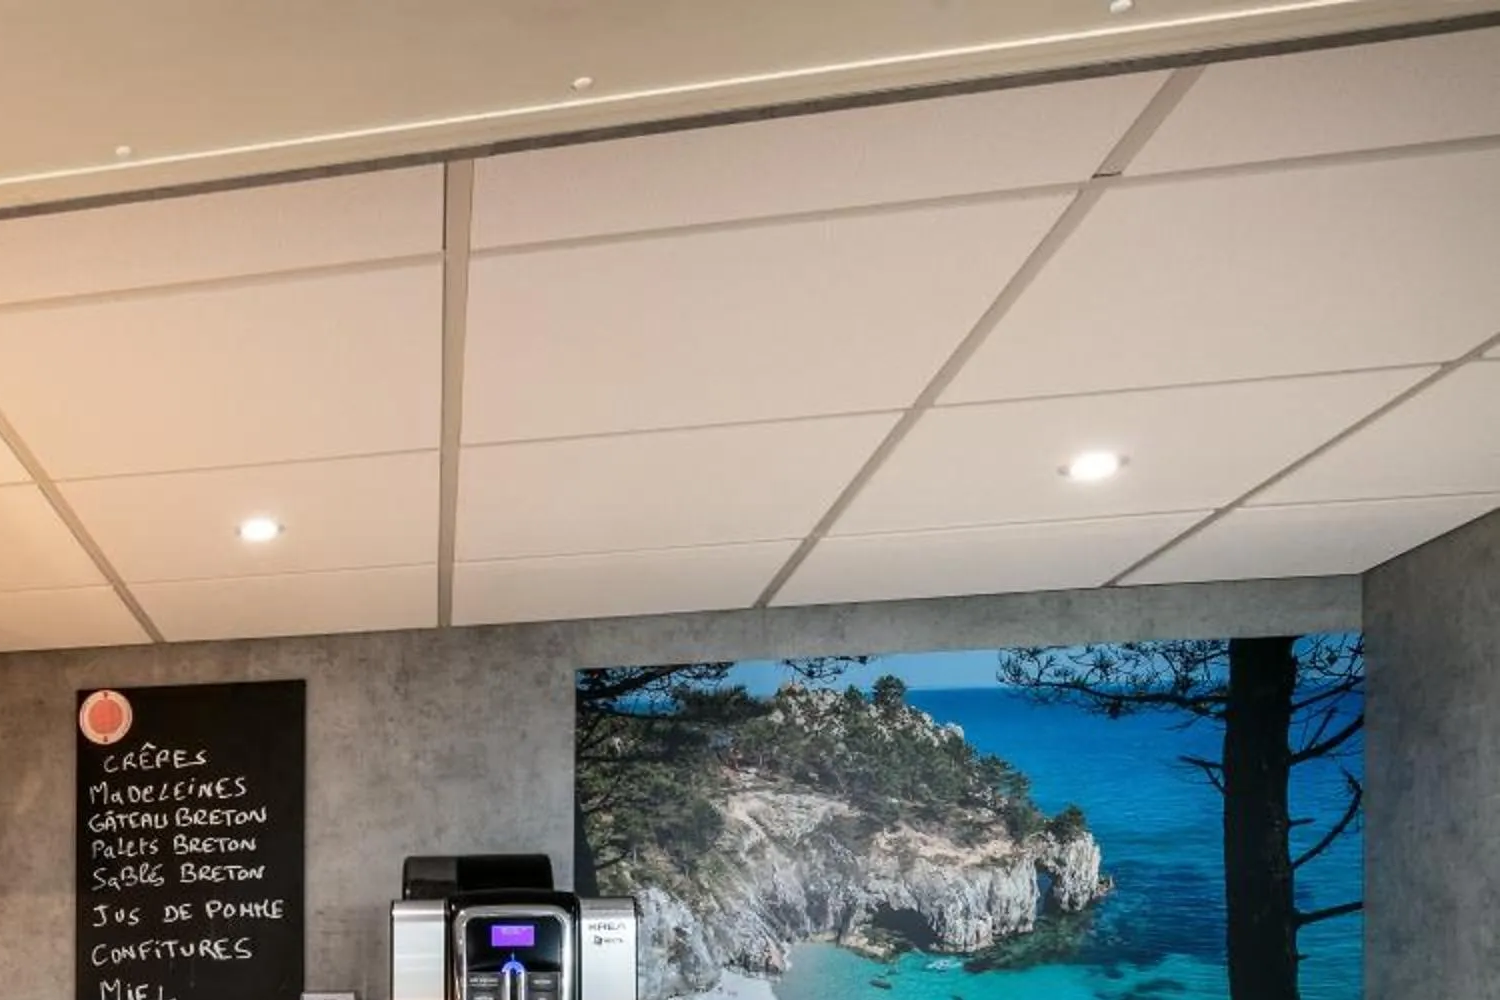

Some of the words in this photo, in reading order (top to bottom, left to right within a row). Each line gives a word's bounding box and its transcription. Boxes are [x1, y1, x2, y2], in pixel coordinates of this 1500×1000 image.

[103, 742, 207, 773] CRÊPES
[175, 807, 267, 827] BRETON
[173, 833, 257, 855] BRETON
[179, 862, 265, 883] BRETON
[163, 904, 193, 923] DE
